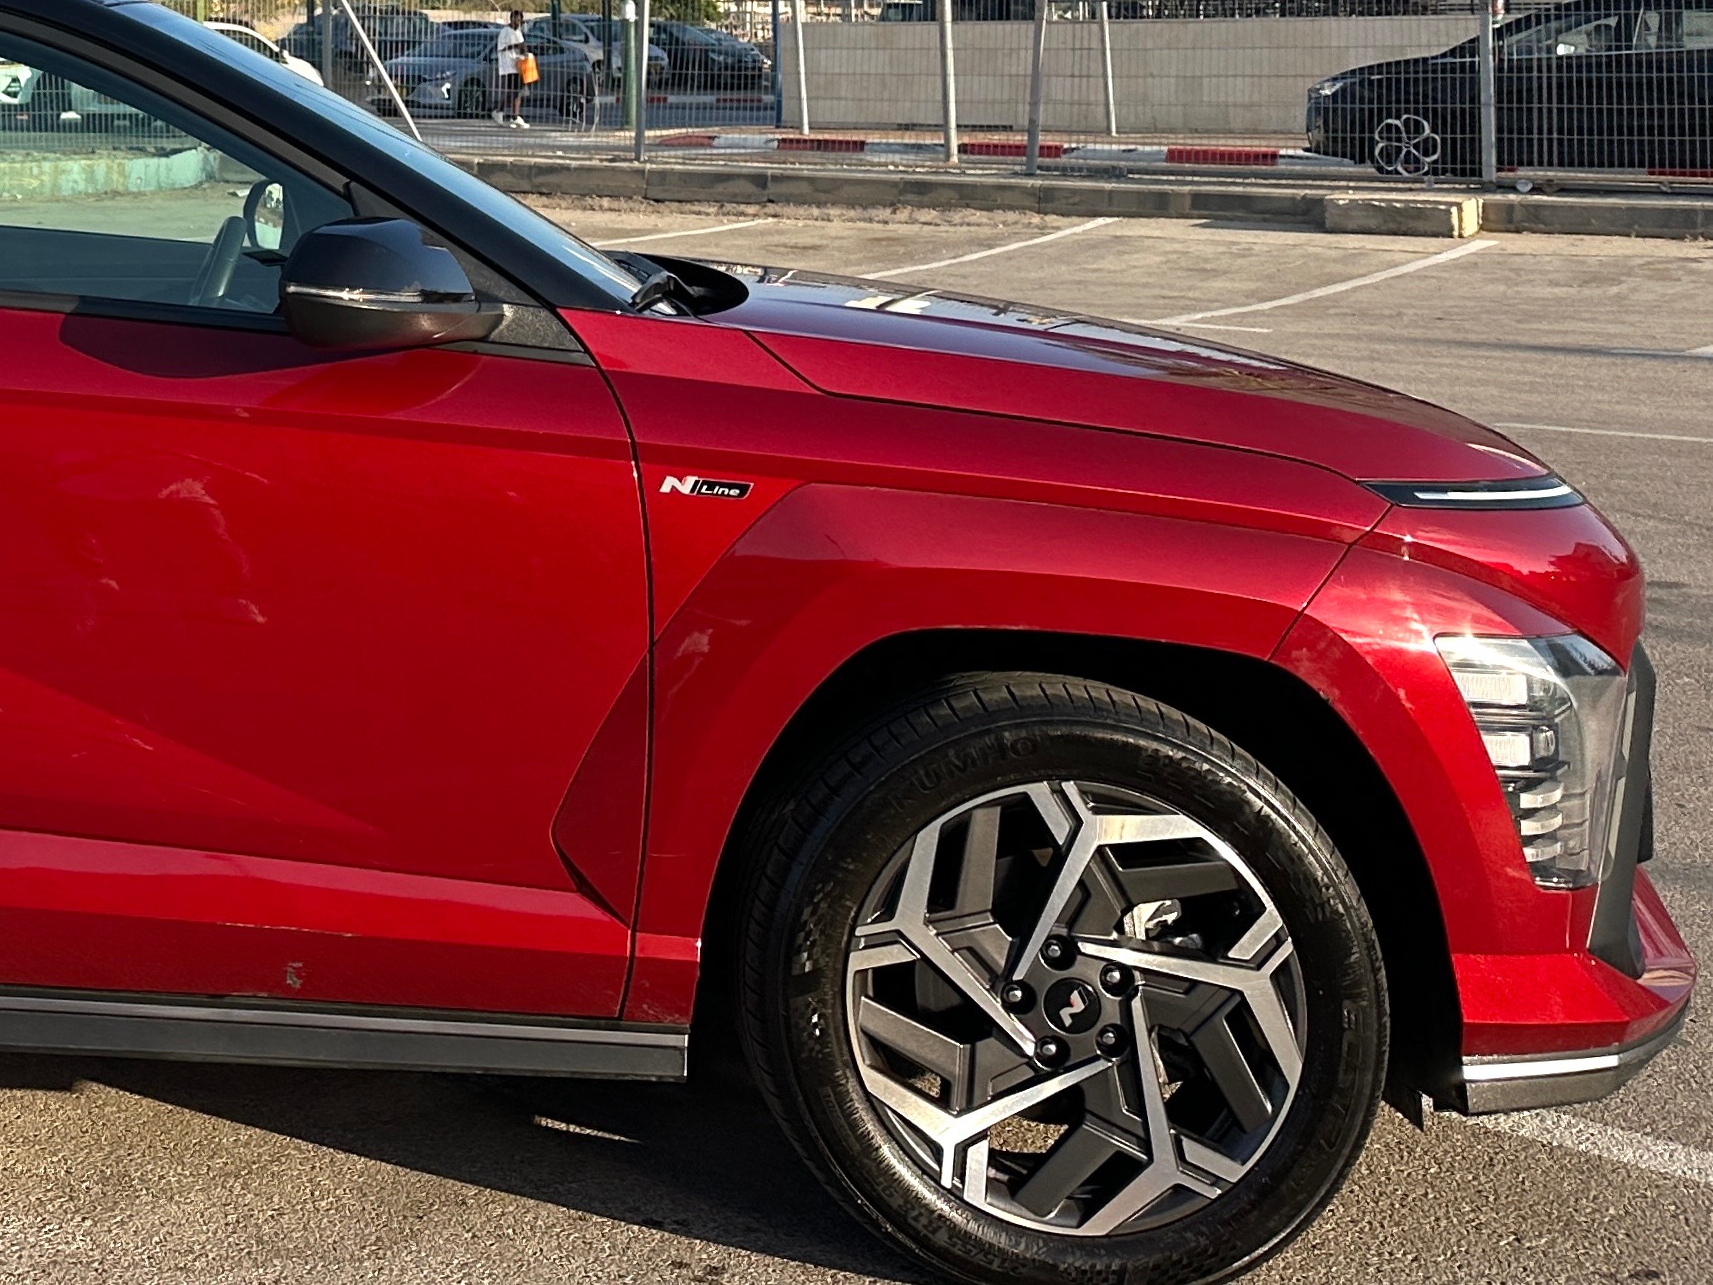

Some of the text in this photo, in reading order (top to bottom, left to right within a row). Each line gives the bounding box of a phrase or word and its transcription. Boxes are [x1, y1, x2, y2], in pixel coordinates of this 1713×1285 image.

[659, 475, 740, 496] N Line
[887, 733, 1042, 813] KUMHO
